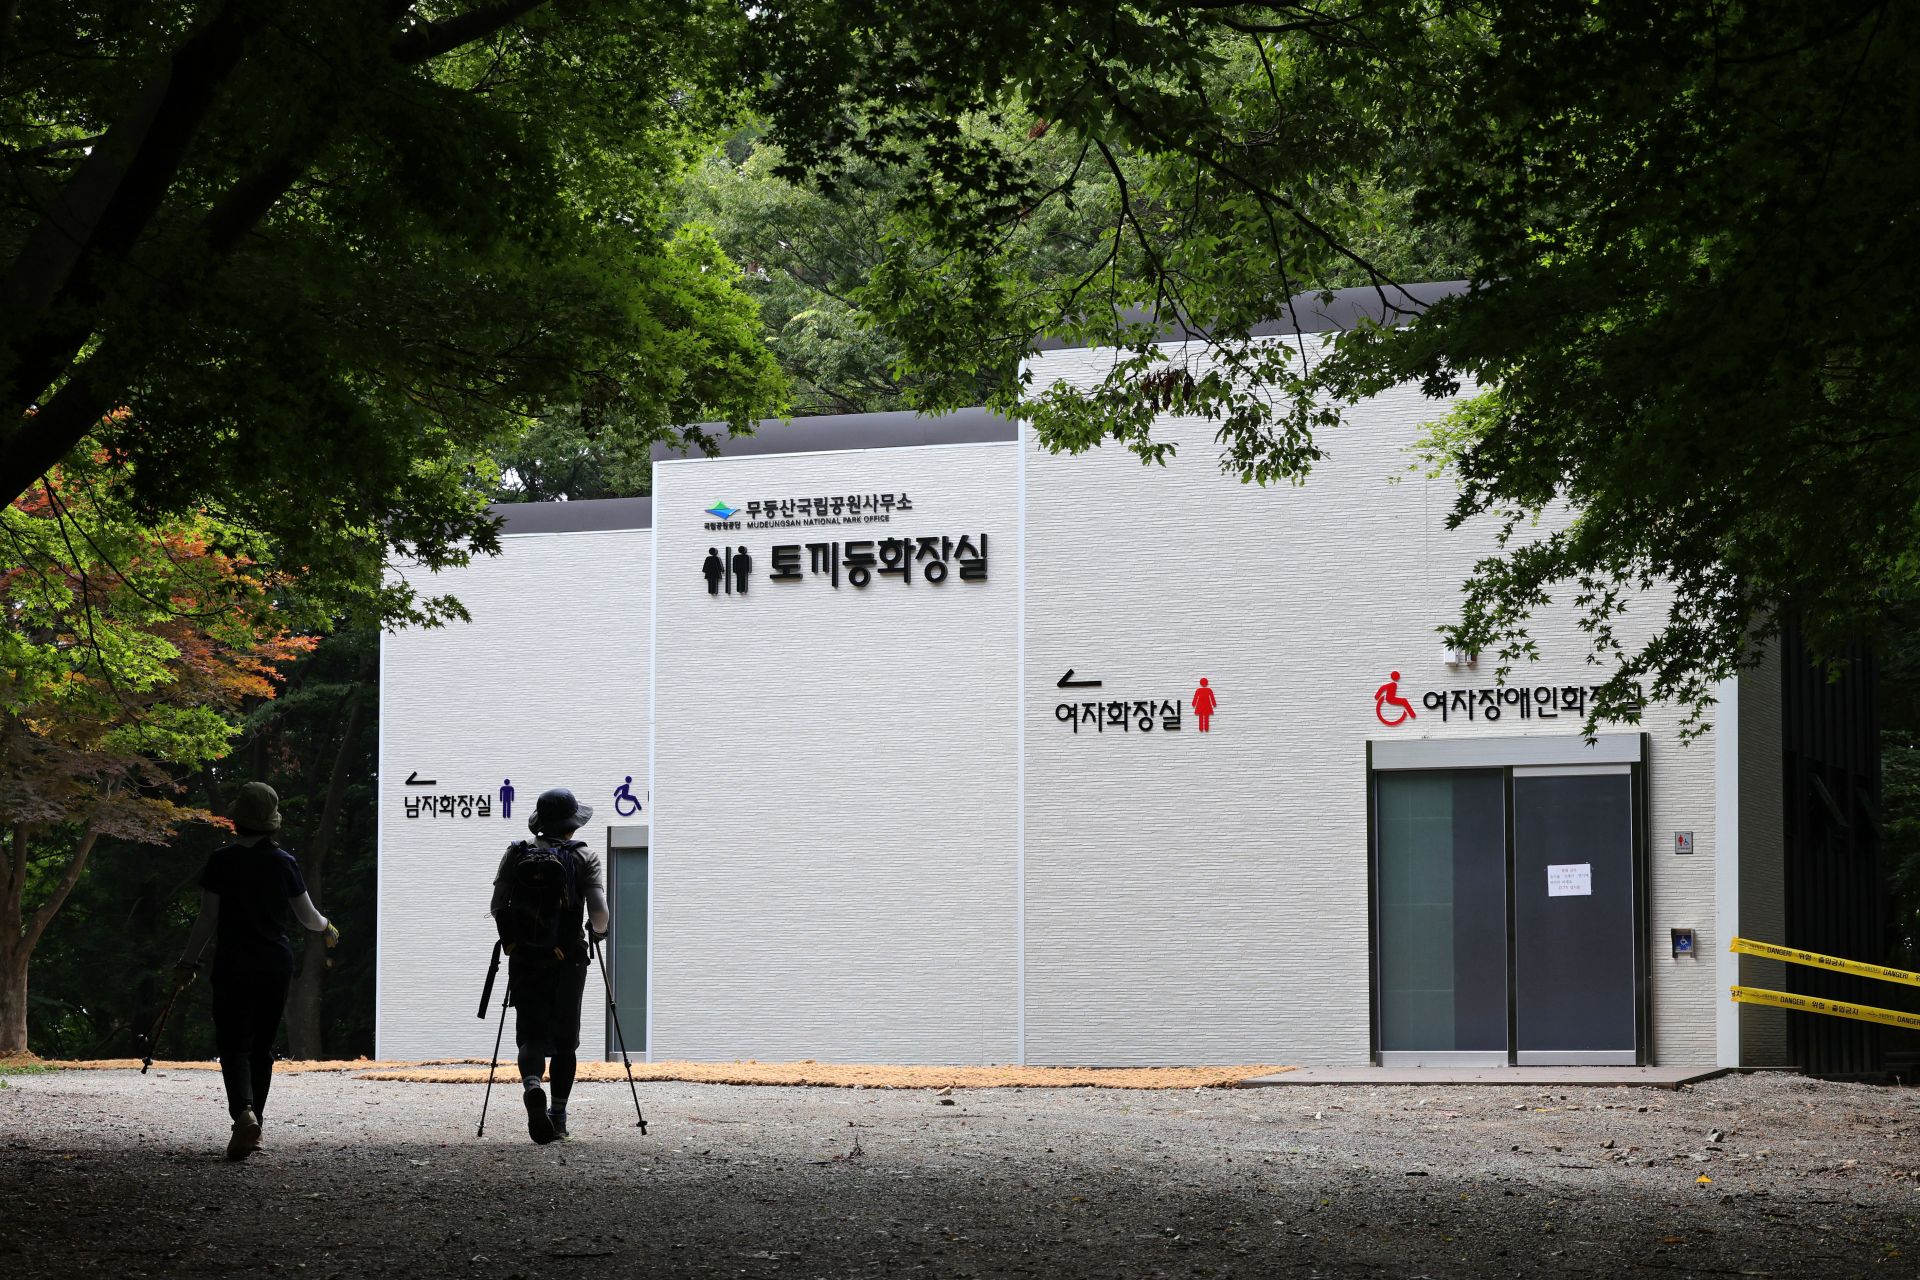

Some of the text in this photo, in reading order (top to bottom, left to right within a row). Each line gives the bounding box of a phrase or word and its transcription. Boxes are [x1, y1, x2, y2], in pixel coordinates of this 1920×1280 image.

[746, 493, 913, 520] 무등산국립공원사무소
[746, 514, 890, 530] MUDEUNGSAN NATIONAL PARK OFFICE
[769, 533, 988, 589] 토끼등화장실
[1055, 700, 1181, 733] 여자화장실
[1423, 685, 1642, 722] 여자장애인화
[404, 795, 491, 818] 남자화장실
